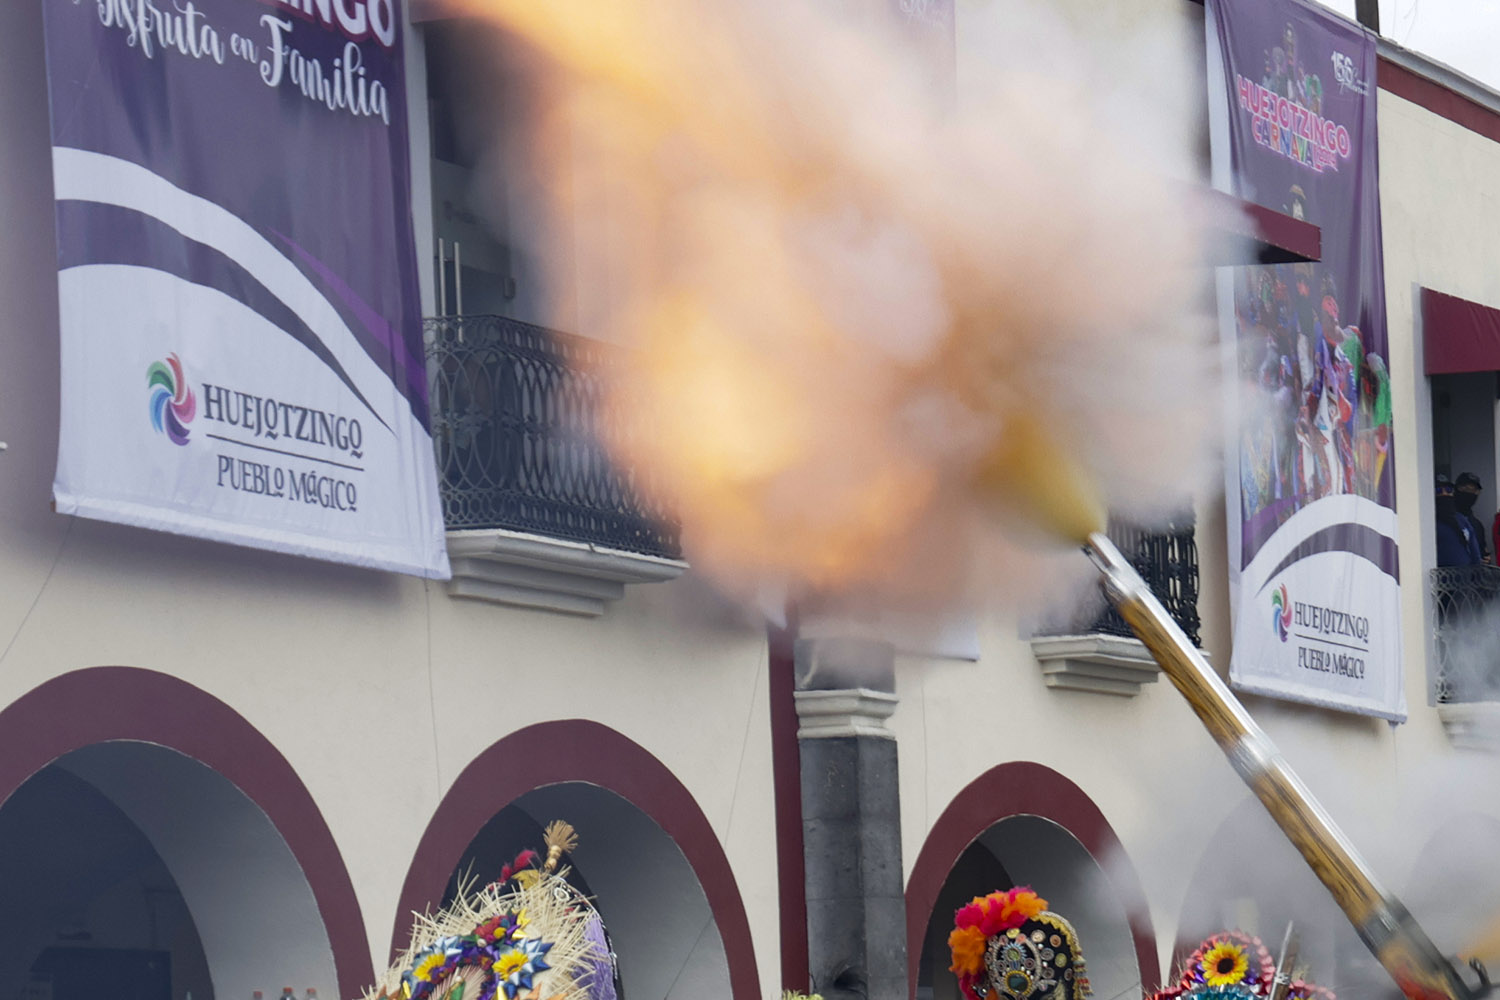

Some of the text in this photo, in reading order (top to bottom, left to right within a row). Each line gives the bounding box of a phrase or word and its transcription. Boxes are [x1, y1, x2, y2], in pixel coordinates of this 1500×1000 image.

[231, 33, 257, 63] en
[260, 14, 390, 125] Familia
[1237, 73, 1350, 158] HUEJOTZINGO
[1252, 114, 1323, 175] CARNAVAL
[202, 383, 364, 459] HUEJOTZINGO
[217, 454, 284, 498] PUEBLO
[1294, 601, 1369, 643] HUEJOTZINGO
[1298, 646, 1330, 672] PUEBLO
